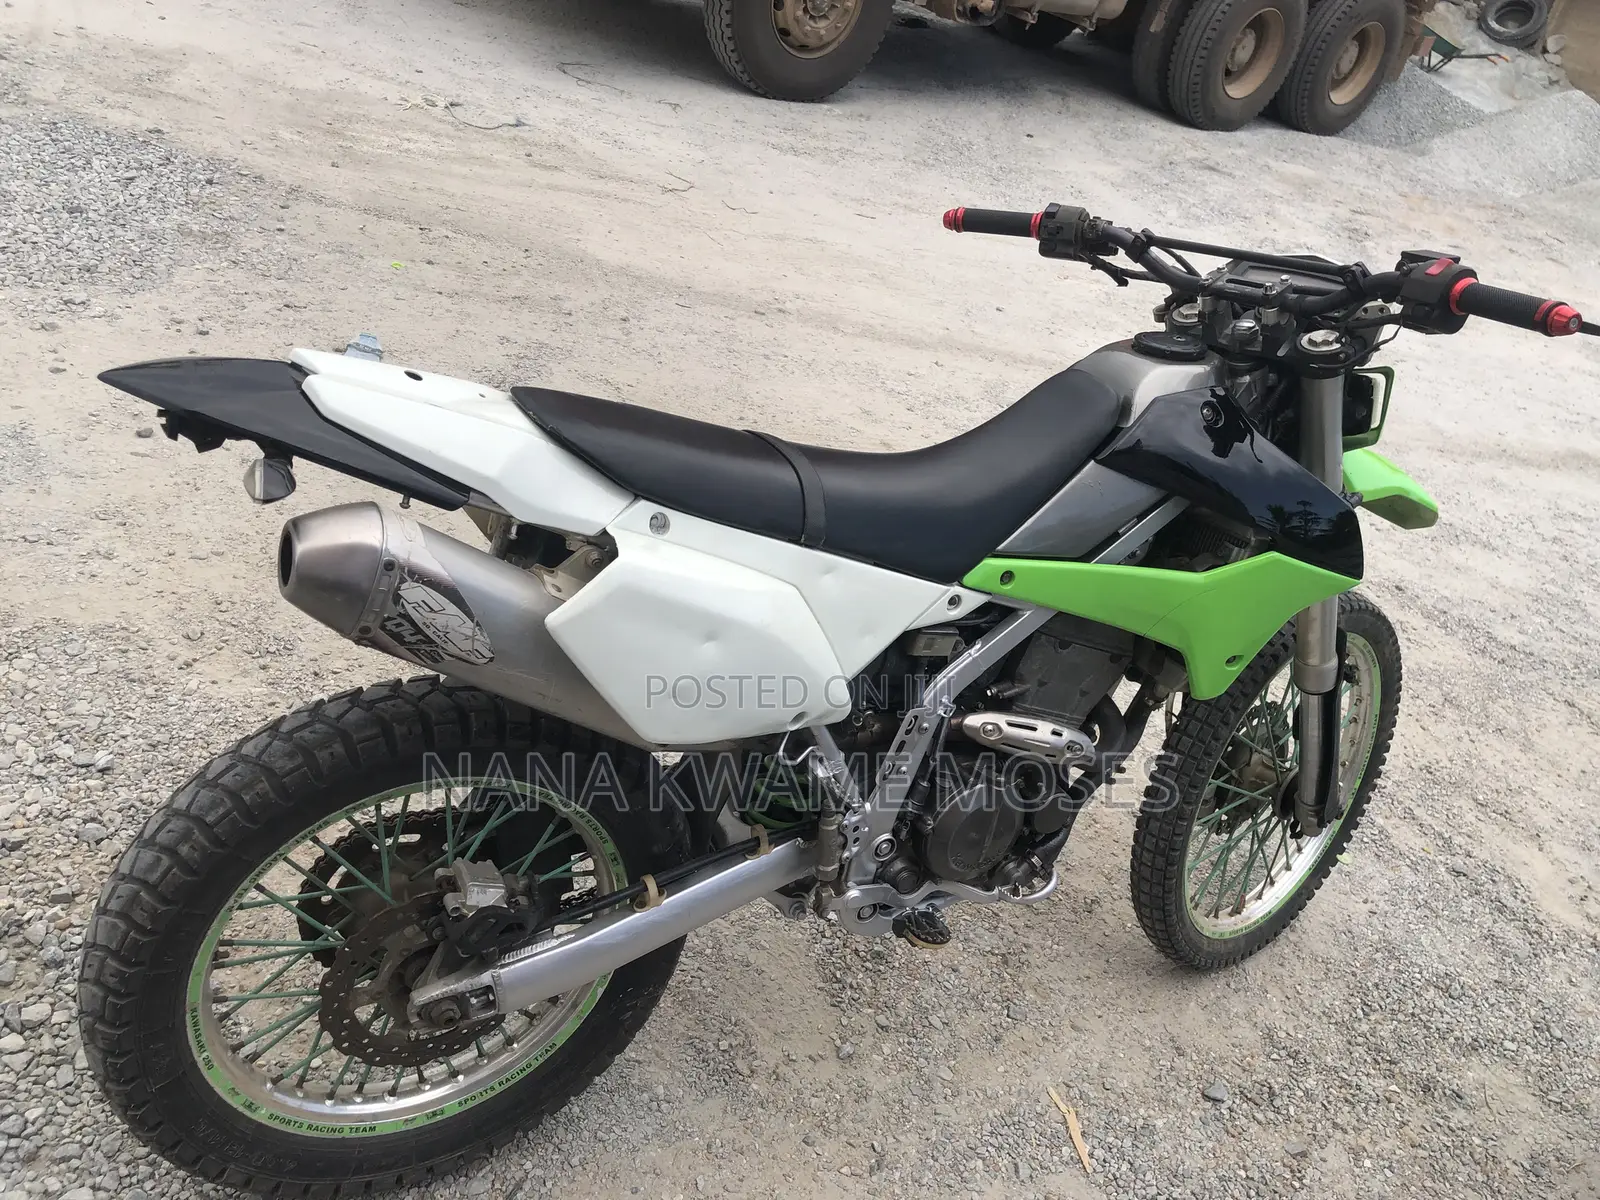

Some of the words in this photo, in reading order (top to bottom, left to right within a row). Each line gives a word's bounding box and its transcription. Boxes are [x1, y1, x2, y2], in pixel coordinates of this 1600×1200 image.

[584, 817, 609, 845] SPORTS
[190, 1007, 207, 1055] KAWASAKI
[202, 1054, 215, 1071] 250
[457, 1086, 496, 1108] SPORTS
[497, 1062, 533, 1088] RACING
[267, 1113, 305, 1129] SPORTS
[306, 1124, 345, 1134] RACING
[348, 1125, 377, 1134] TEAM
